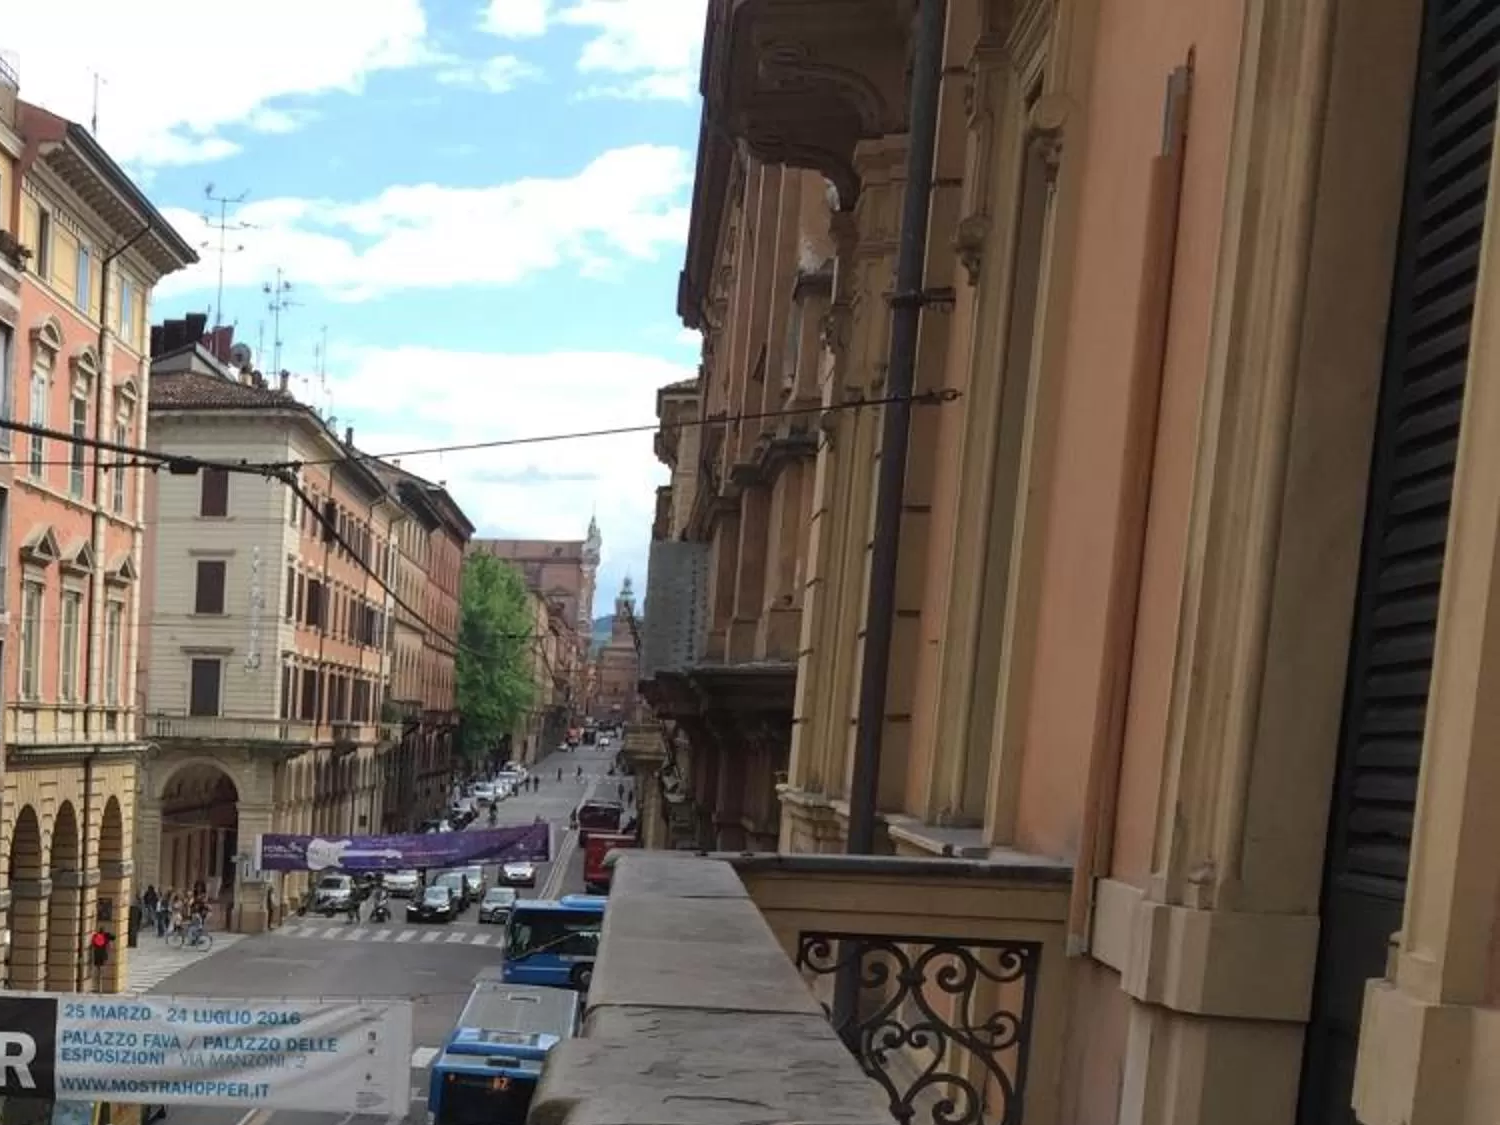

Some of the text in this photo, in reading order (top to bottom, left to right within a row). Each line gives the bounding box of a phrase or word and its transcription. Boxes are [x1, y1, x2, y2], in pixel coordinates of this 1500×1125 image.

[64, 1003, 85, 1019] 25
[90, 1004, 152, 1021] MARZO
[167, 1007, 187, 1022] 24
[193, 1009, 250, 1025] LUGLIO
[258, 1011, 301, 1025] 2016
[62, 1029, 138, 1047] PALAZZO
[143, 1033, 181, 1050] FAVA
[203, 1035, 281, 1051] PALAZZO
[286, 1037, 338, 1053] DELLE
[61, 1047, 165, 1065] ESPOSIZIONI
[60, 1076, 270, 1097] WWW.MOSTRAHOPPER.IT
